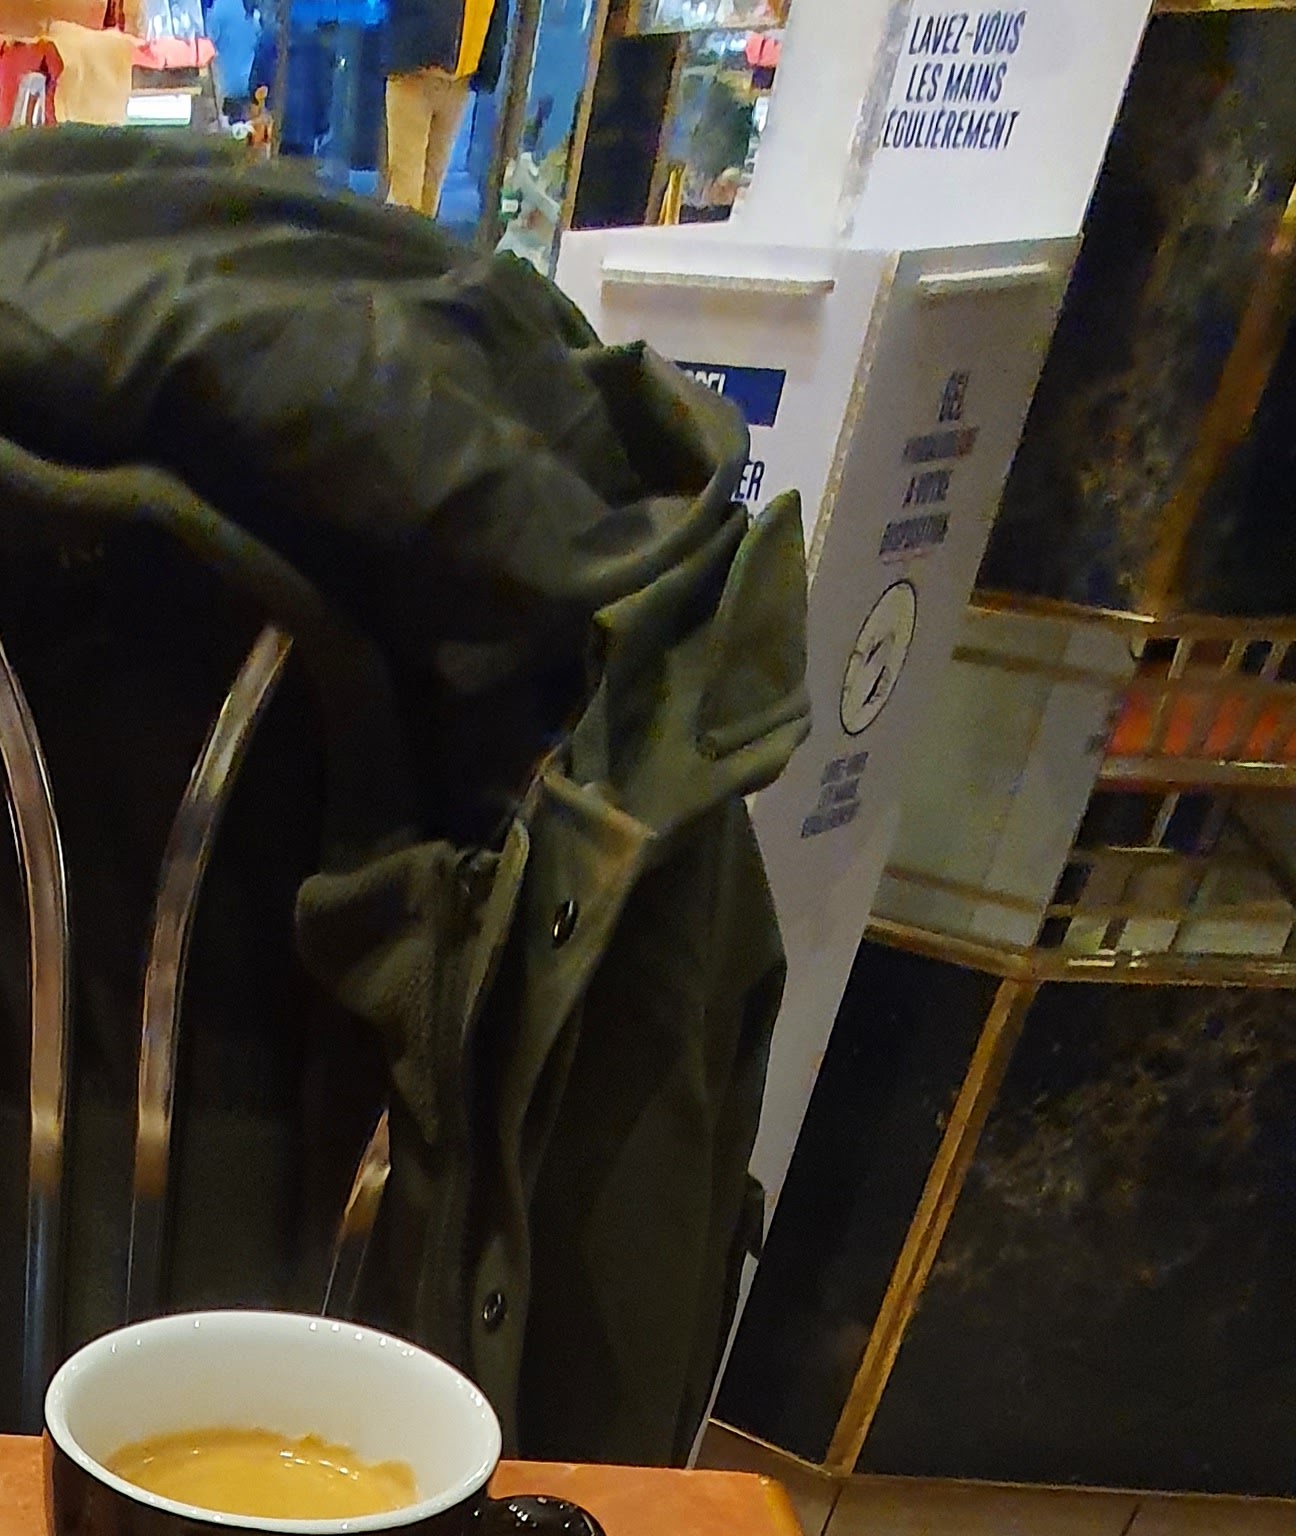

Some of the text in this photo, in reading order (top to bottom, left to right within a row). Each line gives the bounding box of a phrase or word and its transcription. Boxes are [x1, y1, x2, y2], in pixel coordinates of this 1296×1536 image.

[909, 10, 1027, 55] LAVEZ-VOUS
[905, 62, 1008, 103] LES MAINS
[879, 104, 1021, 150] ÉGULIÈREMENT
[734, 460, 766, 502] ER
